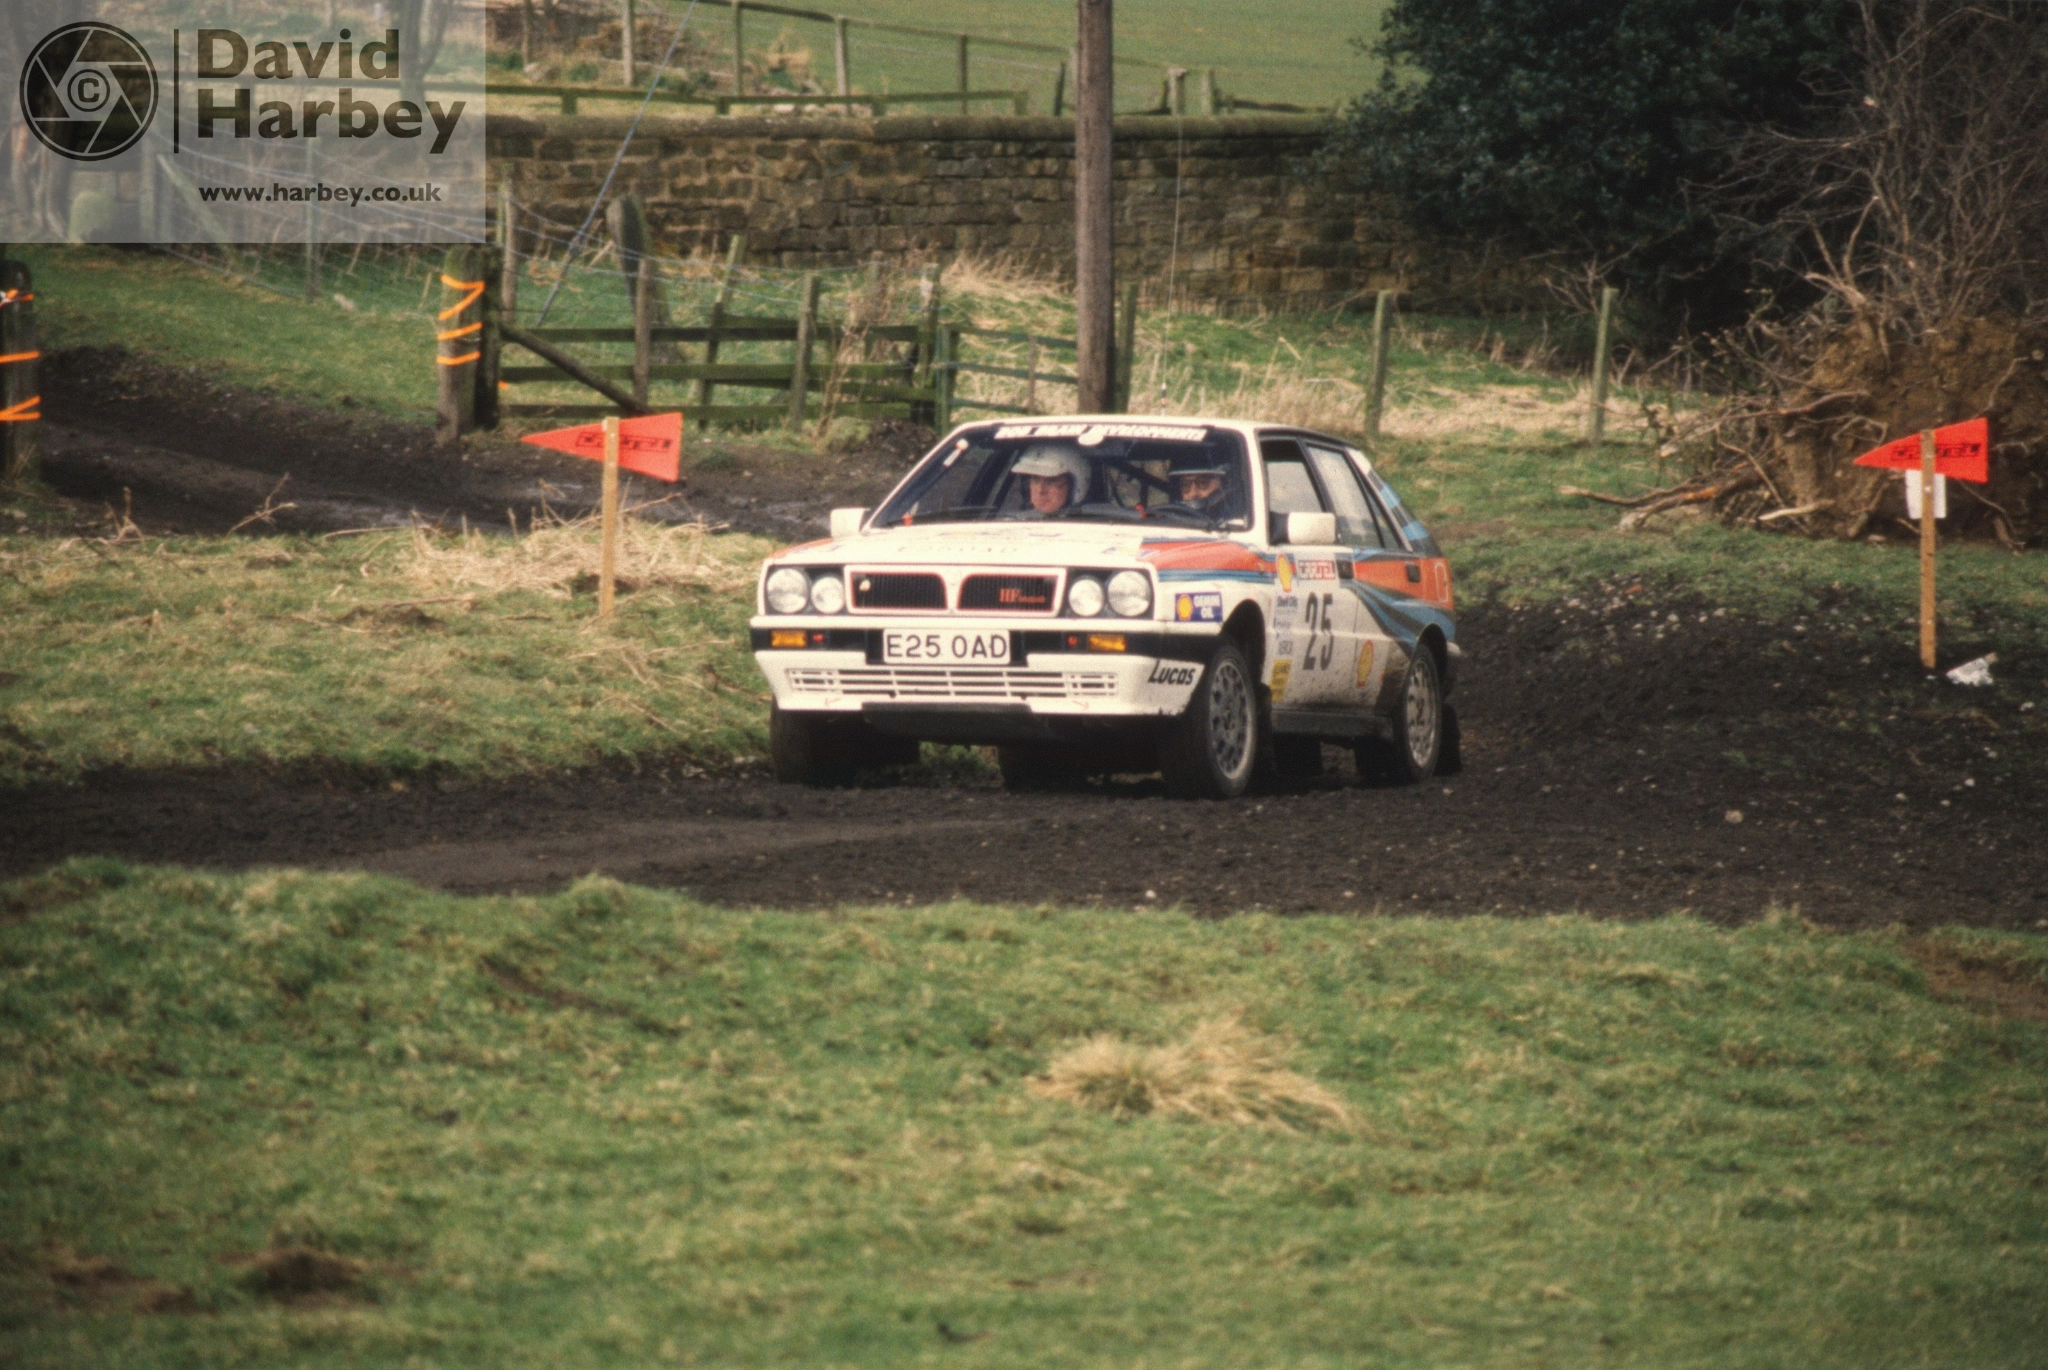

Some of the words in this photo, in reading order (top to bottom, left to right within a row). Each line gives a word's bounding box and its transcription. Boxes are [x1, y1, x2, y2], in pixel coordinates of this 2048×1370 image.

[1302, 591, 1336, 671] 25
[886, 635, 943, 658] E25
[951, 635, 1007, 659] OAD
[1148, 660, 1196, 685] Lucas
